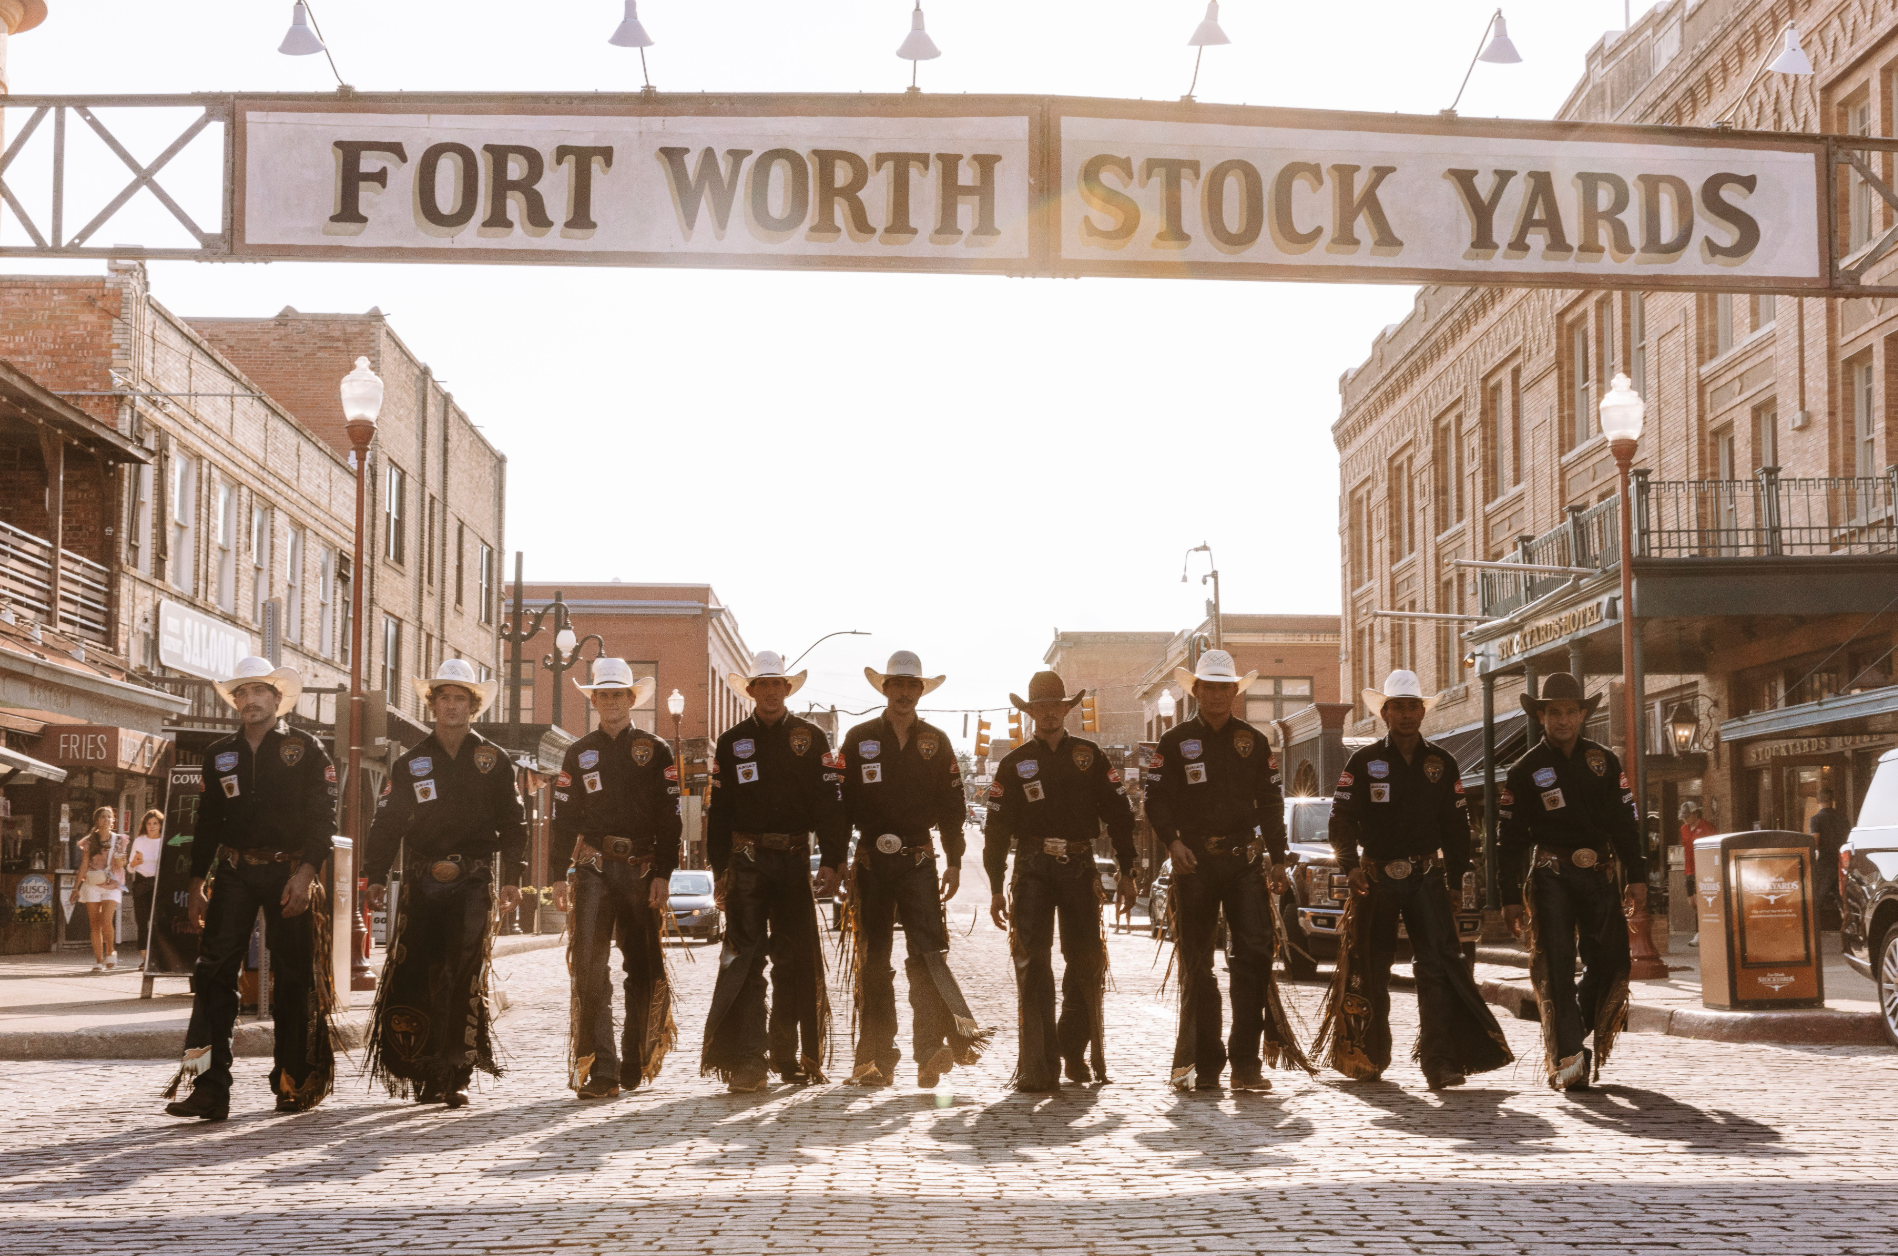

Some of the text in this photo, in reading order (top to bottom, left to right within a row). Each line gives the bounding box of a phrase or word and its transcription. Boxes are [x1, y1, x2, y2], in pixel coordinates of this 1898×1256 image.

[322, 140, 1761, 268] FORT WORTH STOCK YARDS
[183, 617, 235, 678] SALOON
[1497, 600, 1602, 661] STOCKYARDS HOTEL
[59, 733, 107, 760] FRIES
[1750, 736, 1827, 762] STOCKYARDS
[19, 885, 49, 895] BUSCH
